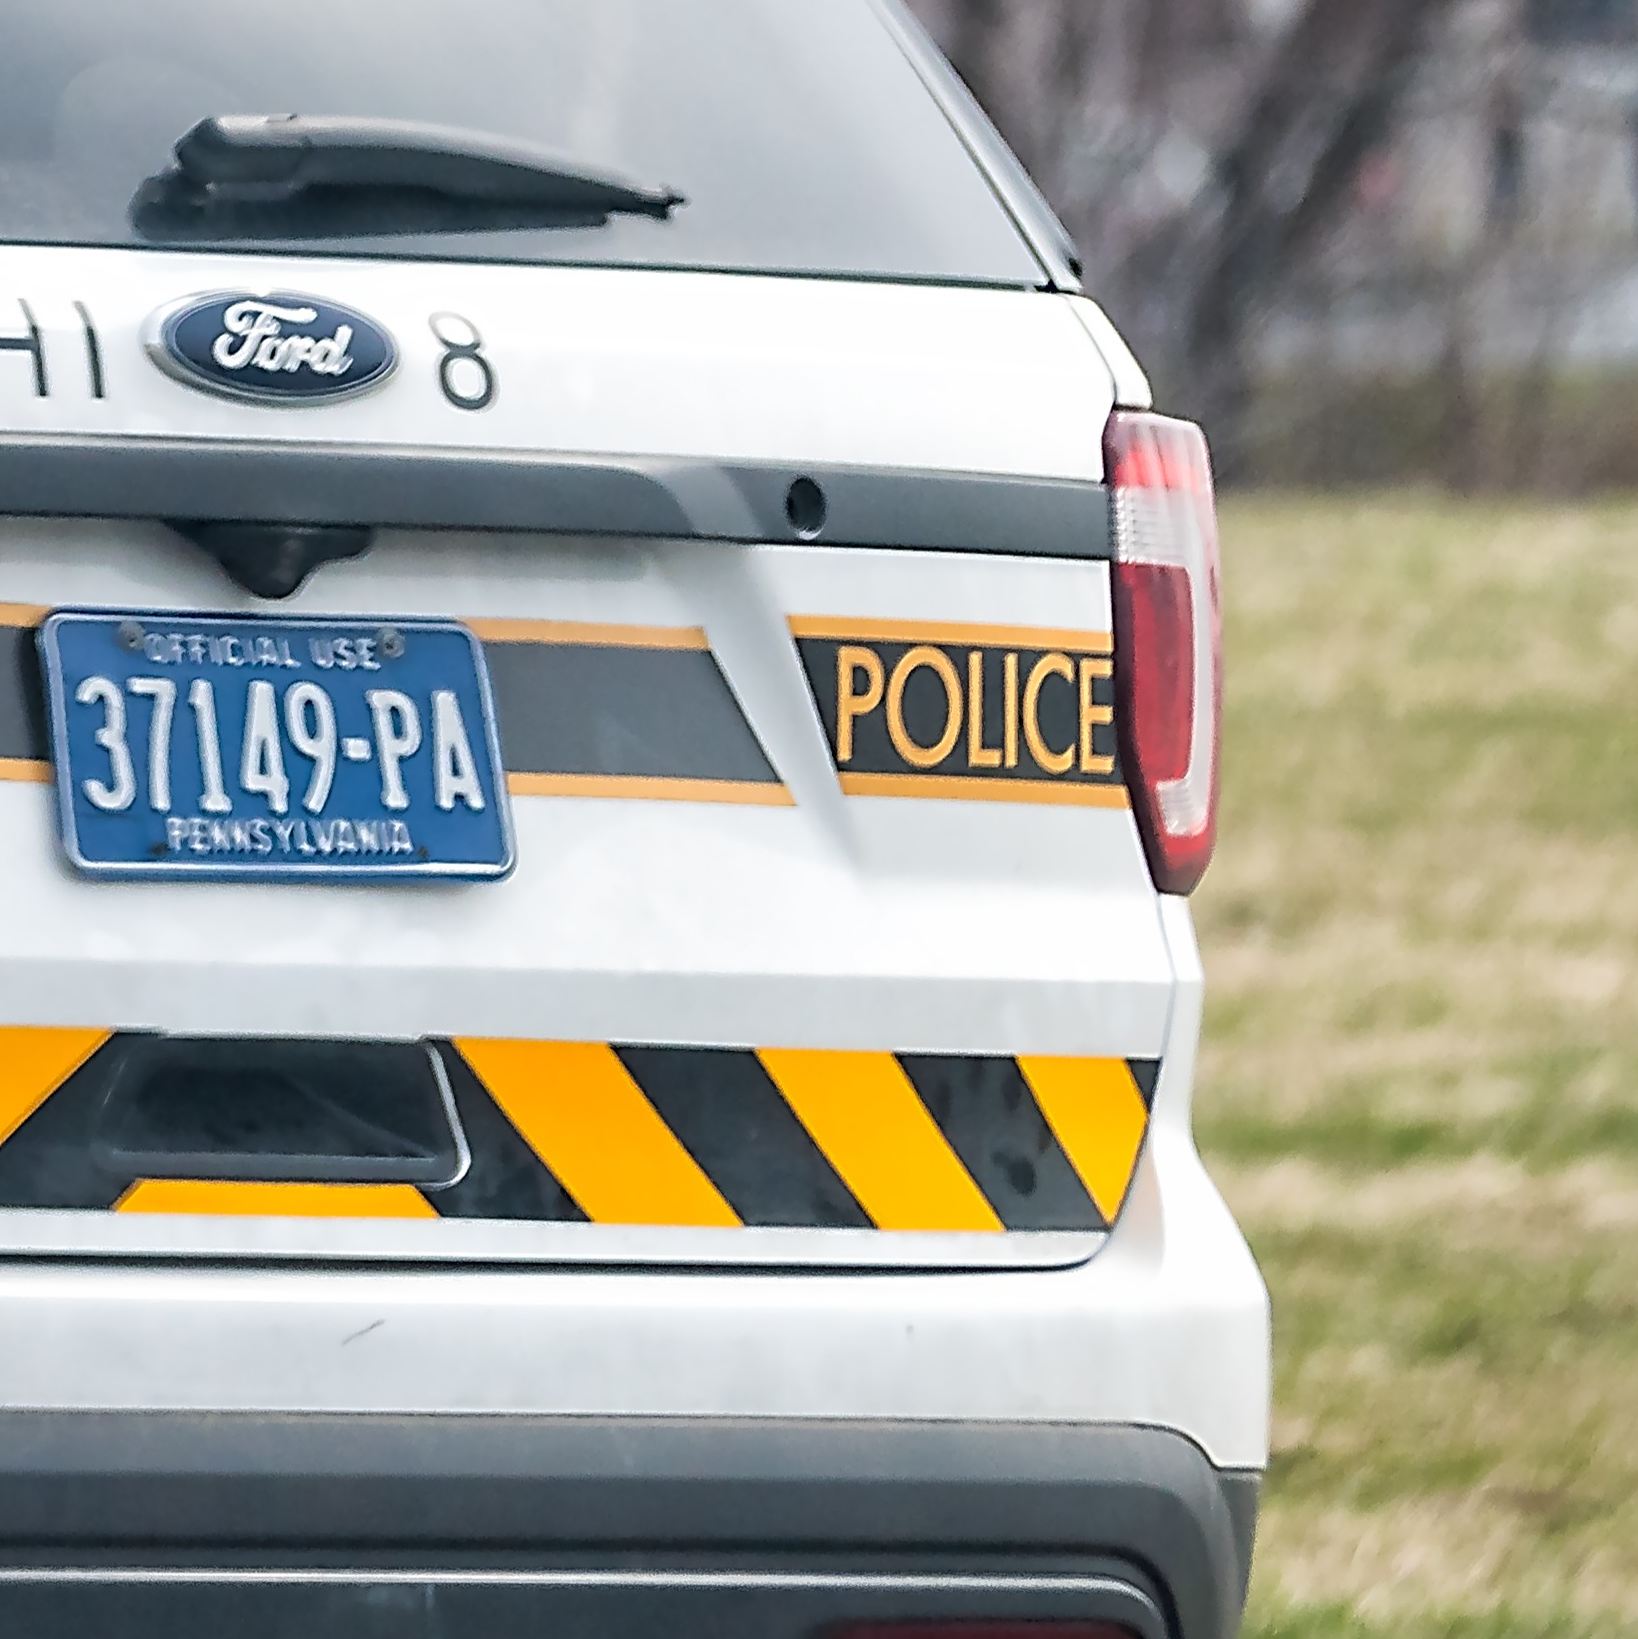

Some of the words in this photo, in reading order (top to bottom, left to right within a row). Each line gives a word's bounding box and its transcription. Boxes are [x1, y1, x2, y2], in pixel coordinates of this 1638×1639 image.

[211, 299, 355, 376] Ford
[428, 310, 498, 412] 8
[144, 633, 302, 669] OFFICIAL
[311, 638, 381, 673] USE
[75, 676, 486, 815] 37149-PA
[836, 644, 1114, 775] POLICE
[165, 817, 414, 855] PENNSYLVANIA
